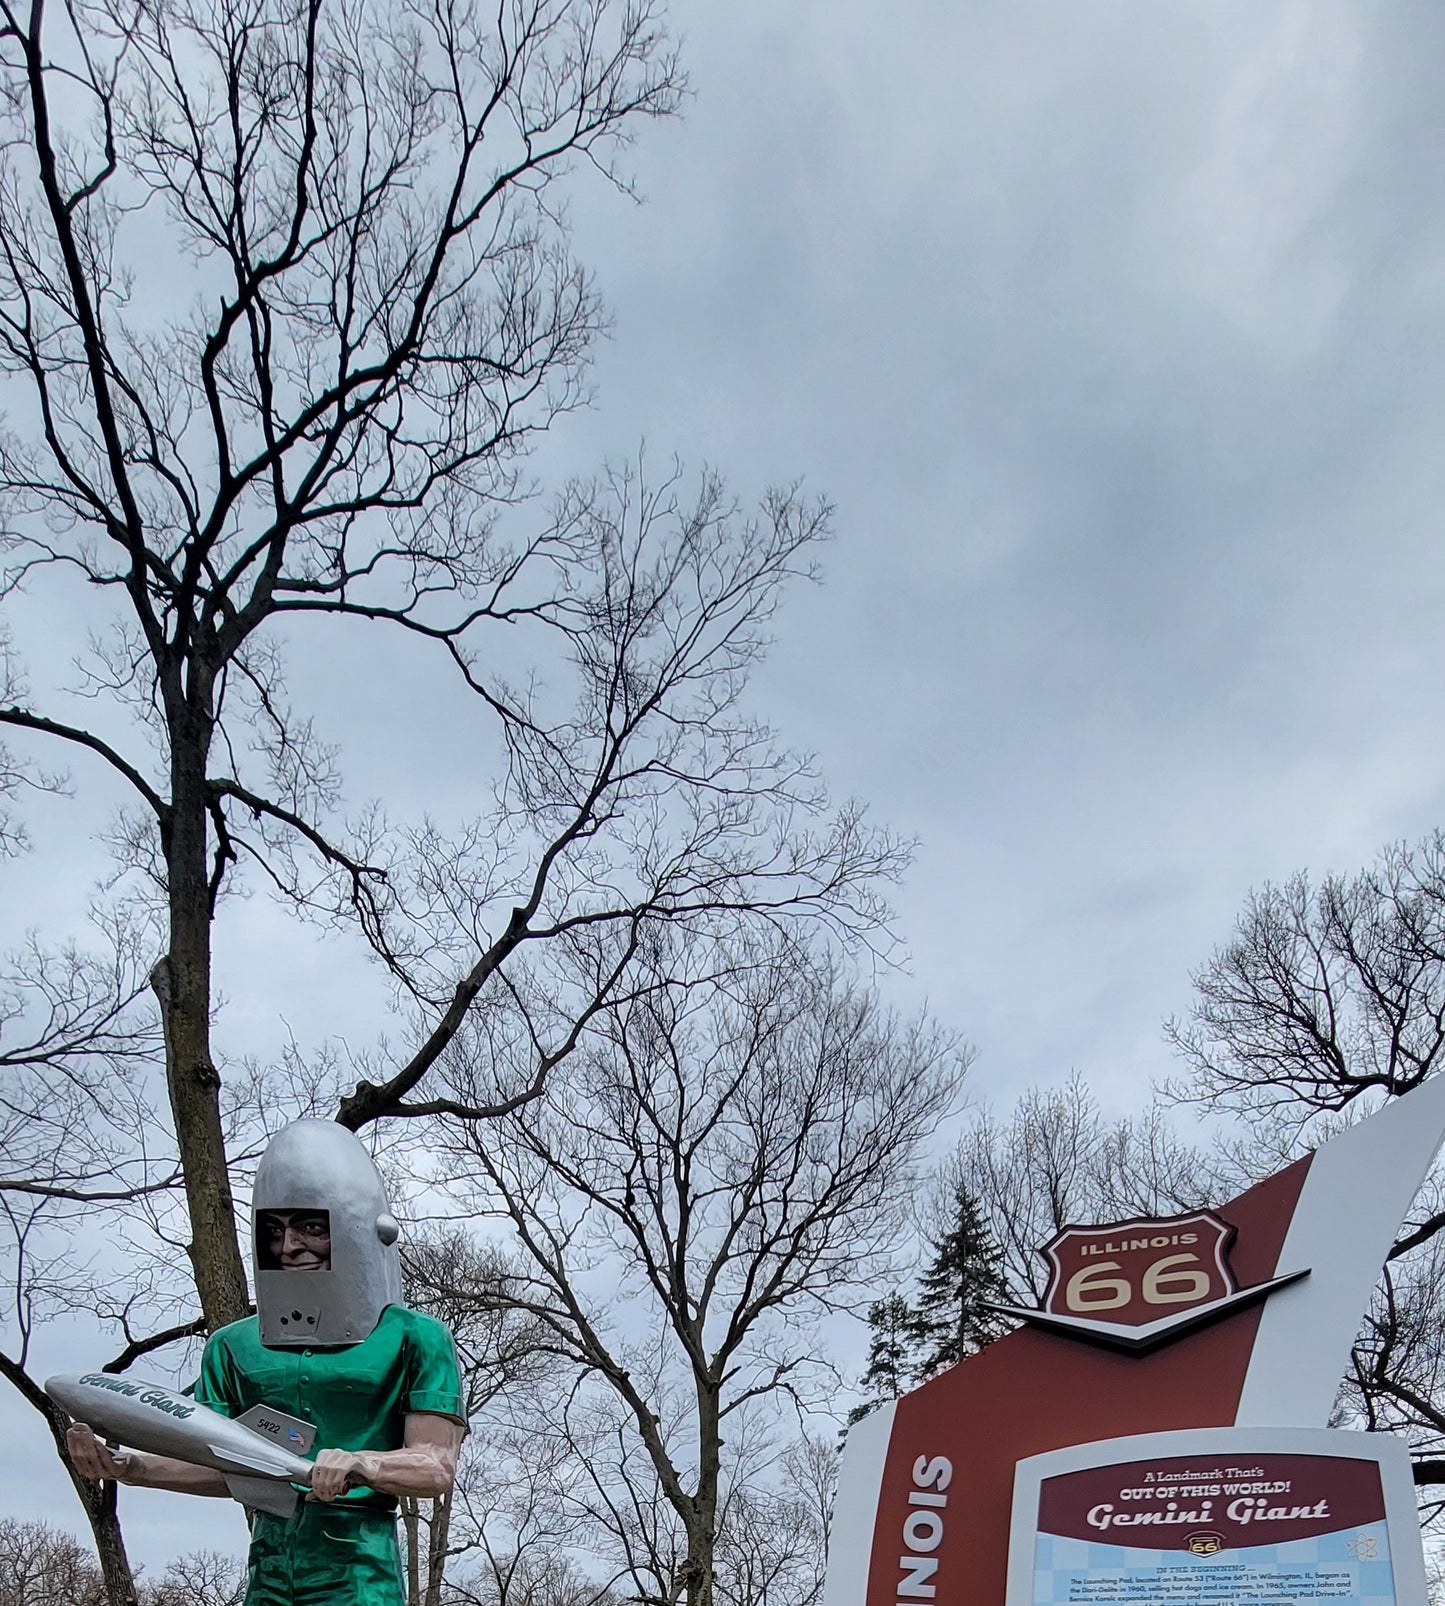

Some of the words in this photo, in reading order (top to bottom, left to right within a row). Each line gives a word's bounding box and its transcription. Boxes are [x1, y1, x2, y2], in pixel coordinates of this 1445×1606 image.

[1081, 1233, 1198, 1256] ILLINOIS
[1066, 1252, 1210, 1312] 66
[79, 1373, 141, 1398] Gemini
[140, 1390, 195, 1419] Giant
[258, 1418, 281, 1434] 5422
[1144, 1473, 1156, 1482] A
[1158, 1469, 1222, 1482] Landmark
[1226, 1467, 1264, 1478] That's
[1120, 1488, 1156, 1500] OUT
[1158, 1487, 1179, 1498] OF
[1179, 1485, 1220, 1497] THIS
[1223, 1481, 1291, 1496] WORLD!
[1087, 1501, 1214, 1530] Gemini
[1226, 1498, 1330, 1524] Giant
[1192, 1542, 1217, 1552] 66
